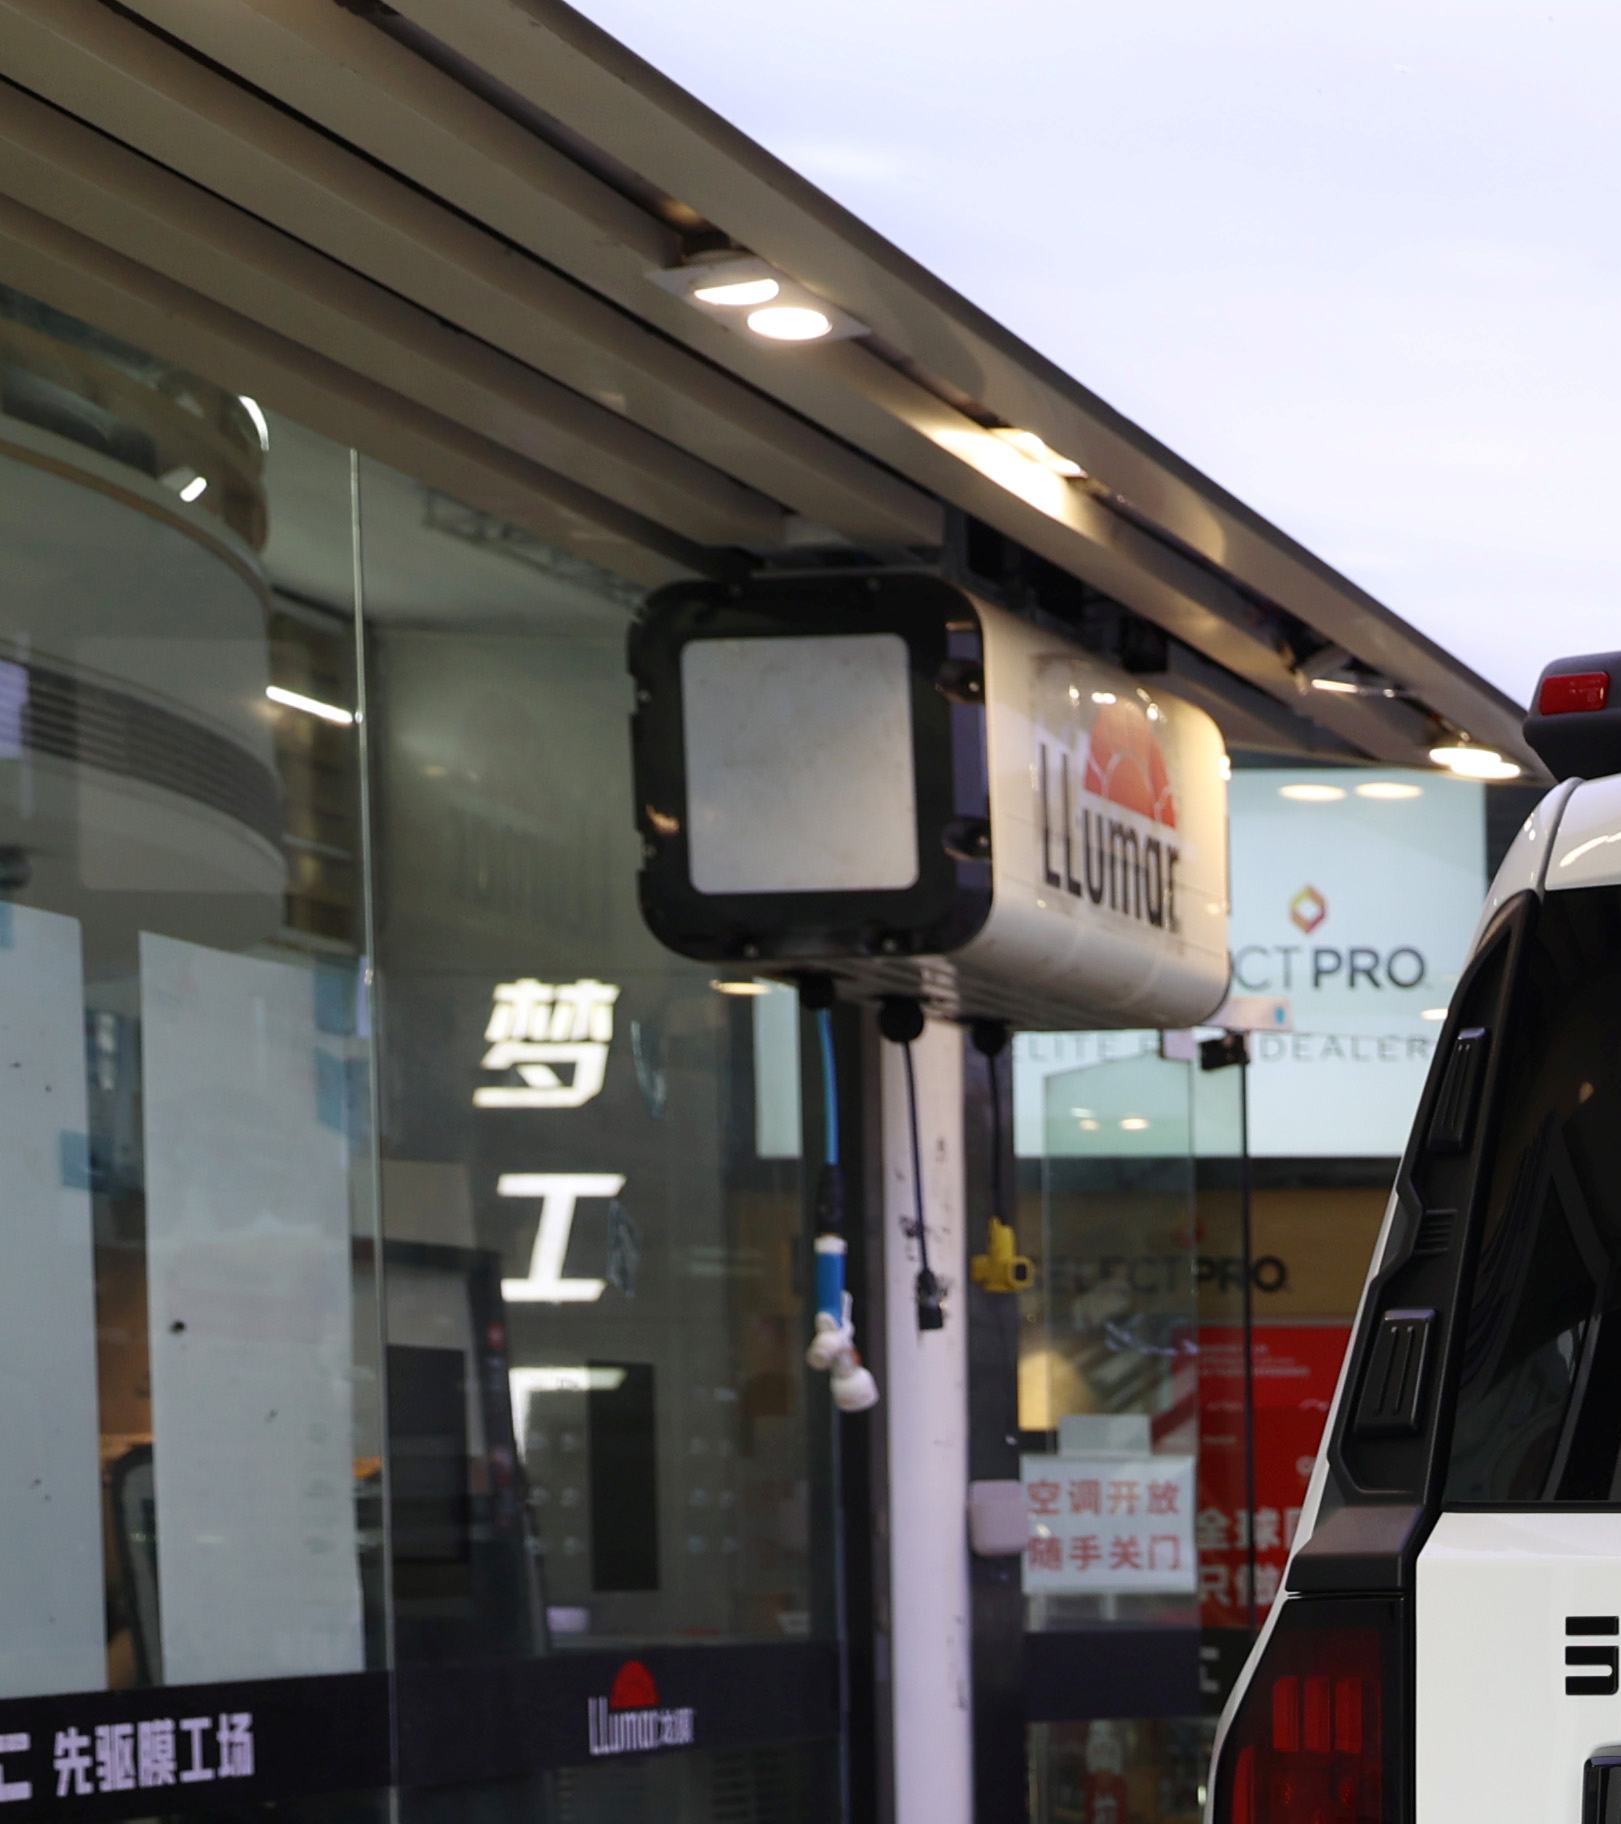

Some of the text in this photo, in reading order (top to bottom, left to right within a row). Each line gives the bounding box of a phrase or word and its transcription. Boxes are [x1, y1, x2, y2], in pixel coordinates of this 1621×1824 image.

[1039, 742, 1181, 935] LLumar
[1026, 1478, 1180, 1516] 空调开放
[1026, 1534, 1182, 1572] 随手关门
[53, 1712, 256, 1798] 先驱膜工场
